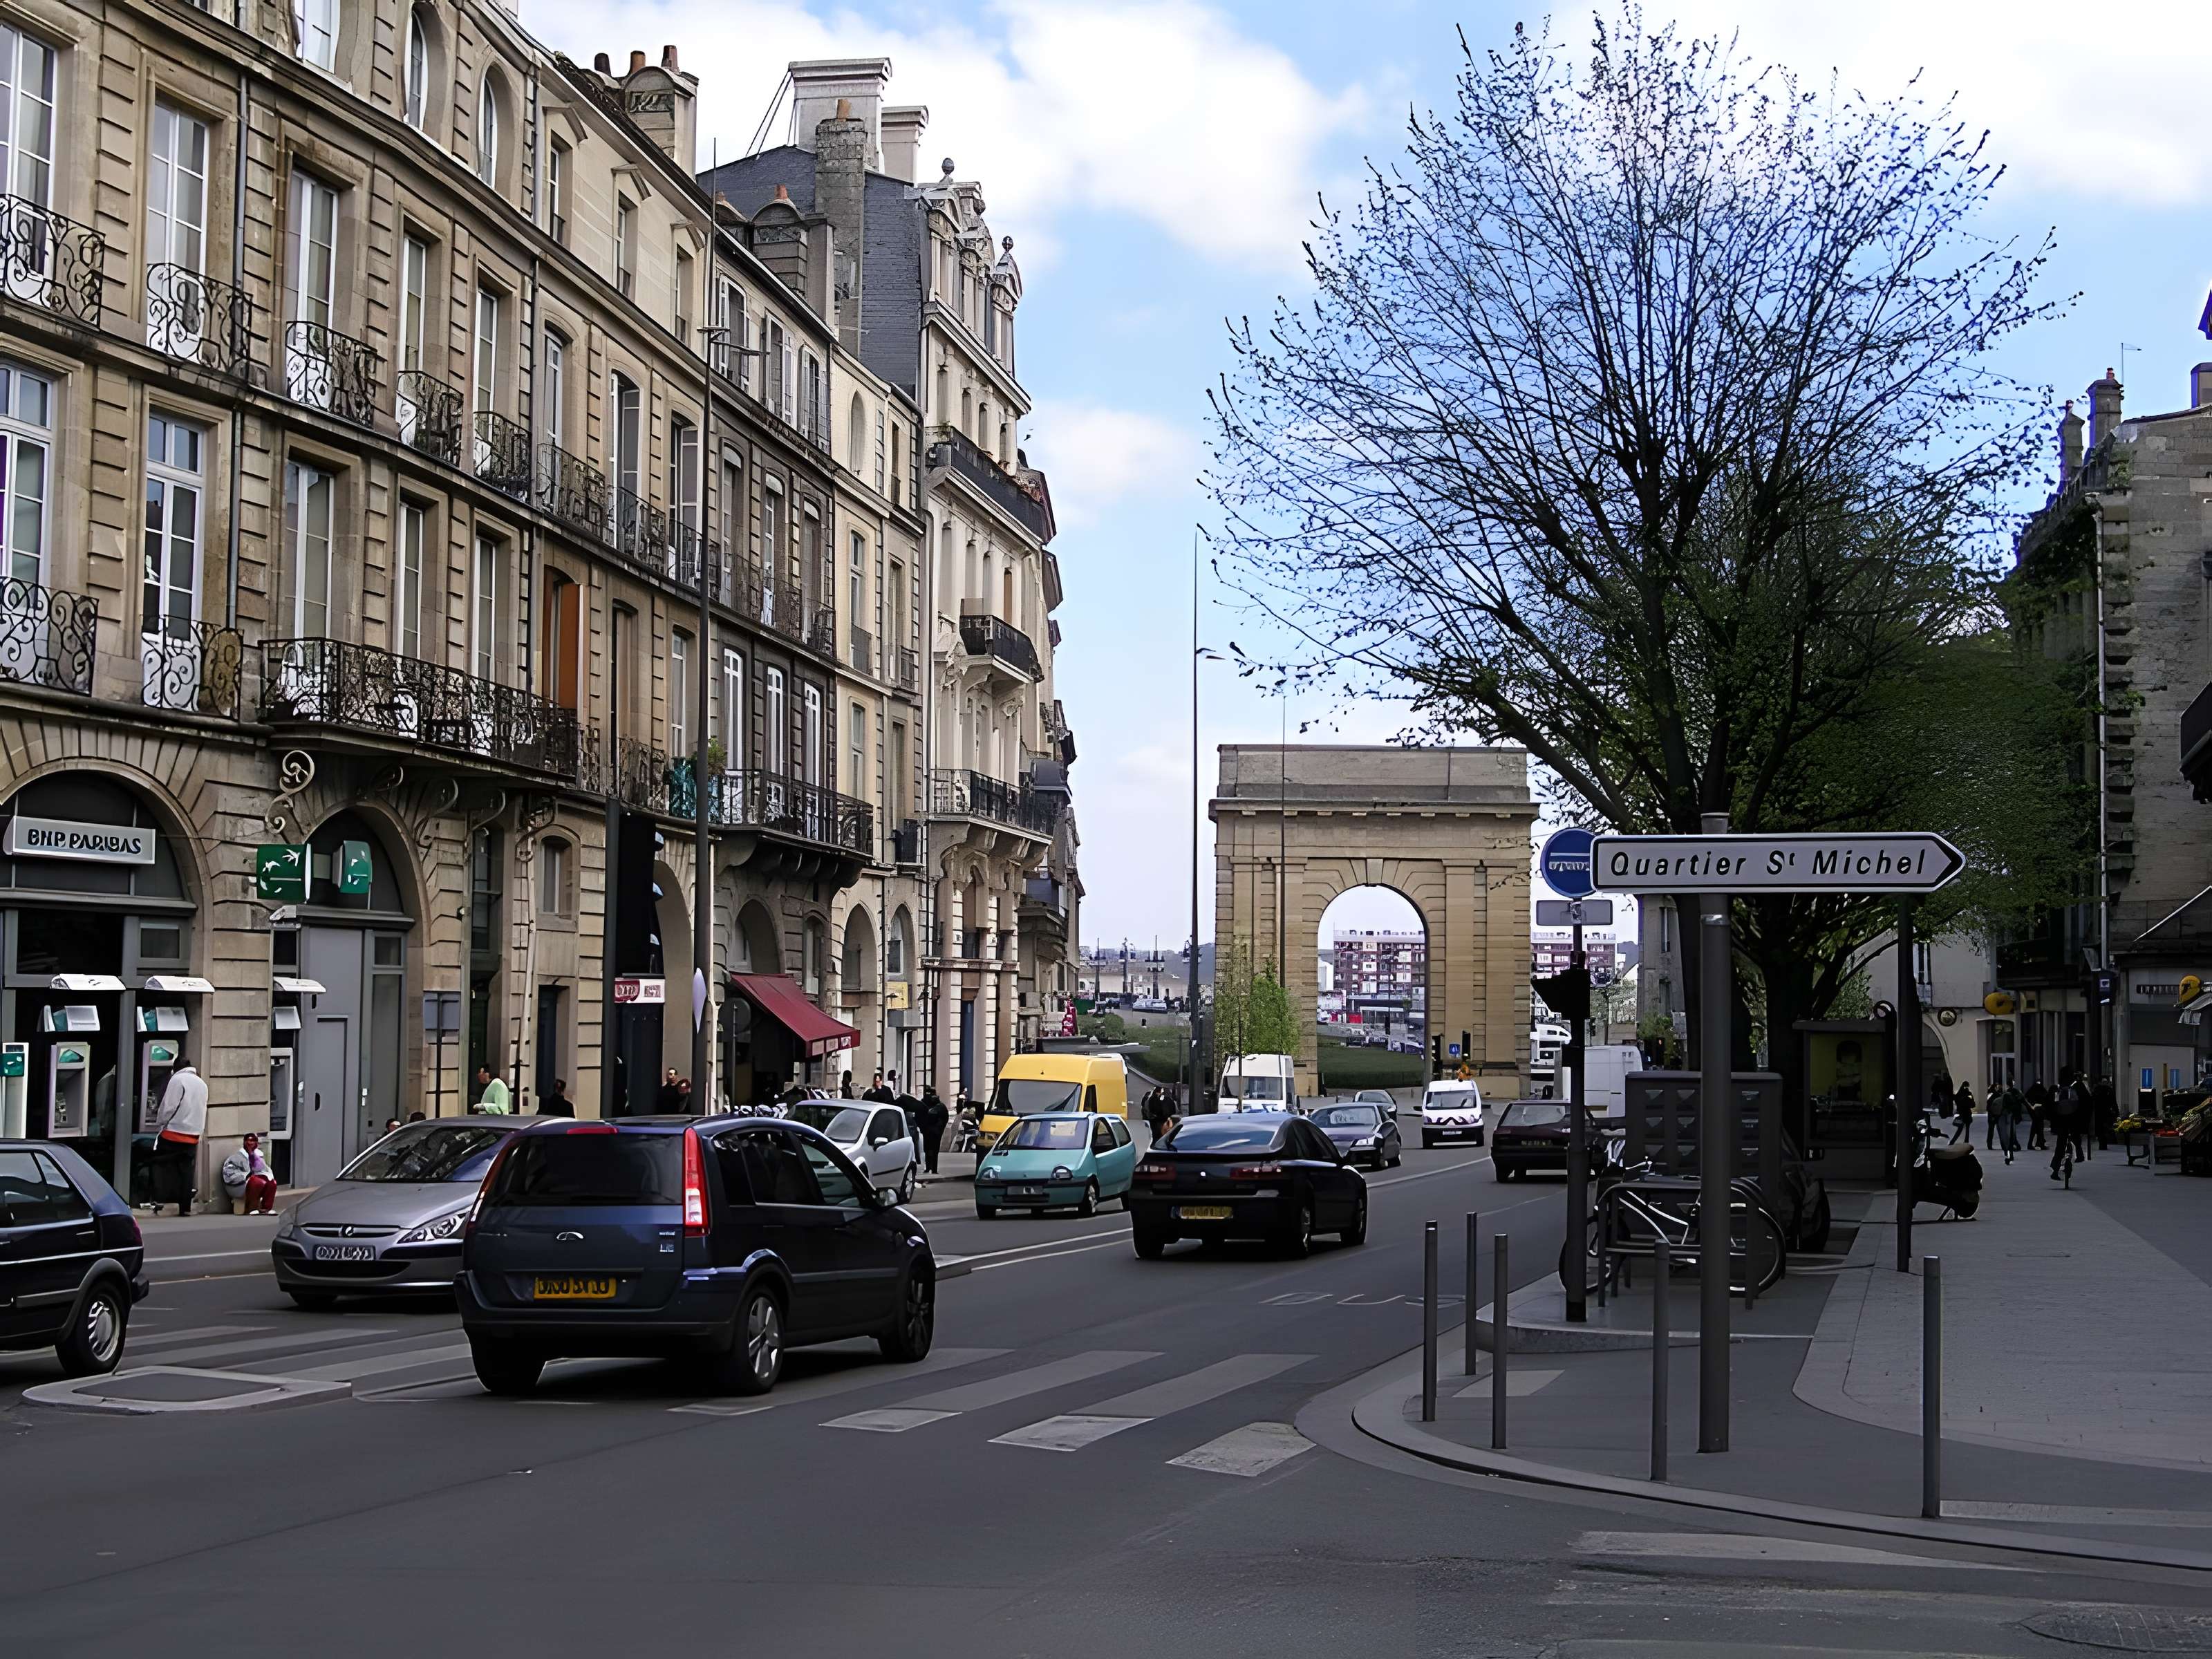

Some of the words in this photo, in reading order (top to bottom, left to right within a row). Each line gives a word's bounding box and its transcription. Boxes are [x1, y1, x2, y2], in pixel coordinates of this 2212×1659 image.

[28, 828, 66, 847] BNP
[1610, 850, 1747, 876] Quartier
[1766, 850, 1795, 875] St
[1812, 849, 1925, 874] Michel
